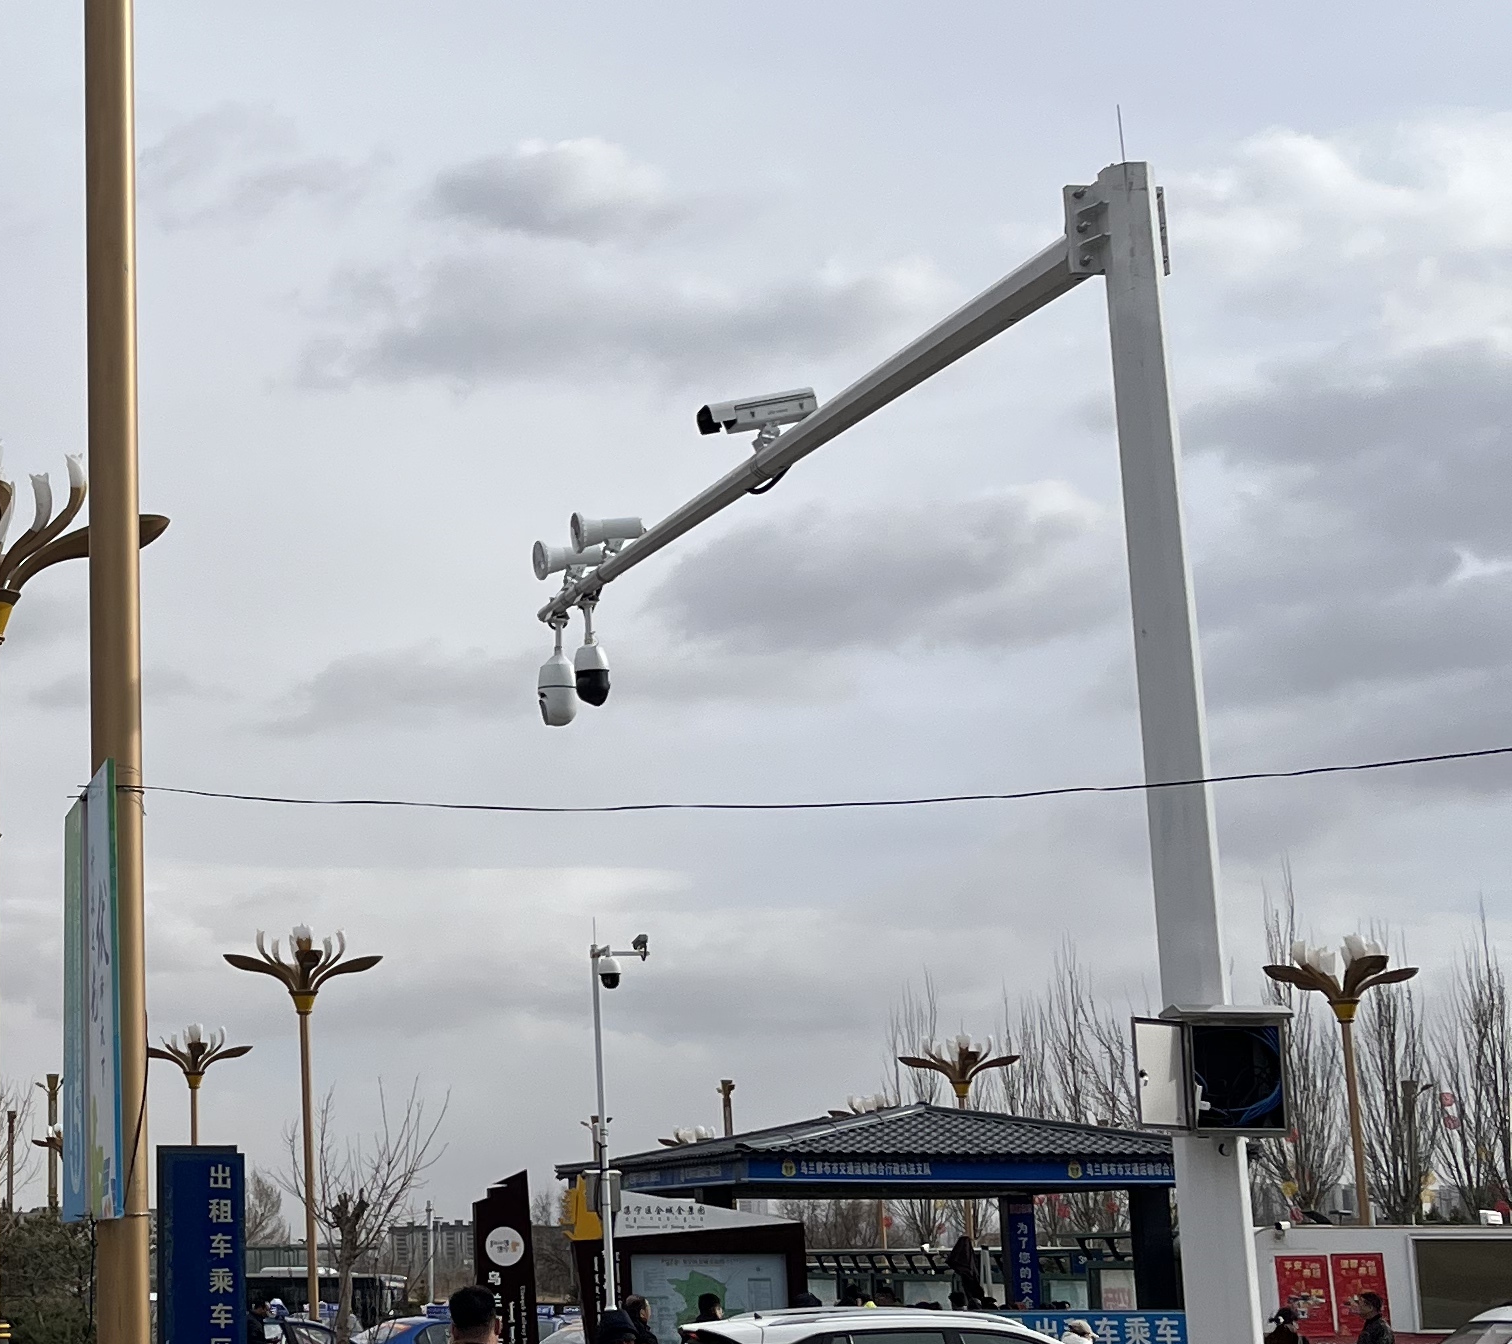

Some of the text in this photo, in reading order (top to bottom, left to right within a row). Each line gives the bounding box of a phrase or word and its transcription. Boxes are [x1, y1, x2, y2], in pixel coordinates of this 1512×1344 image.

[1017, 1222, 1034, 1309] 为了您的安全
